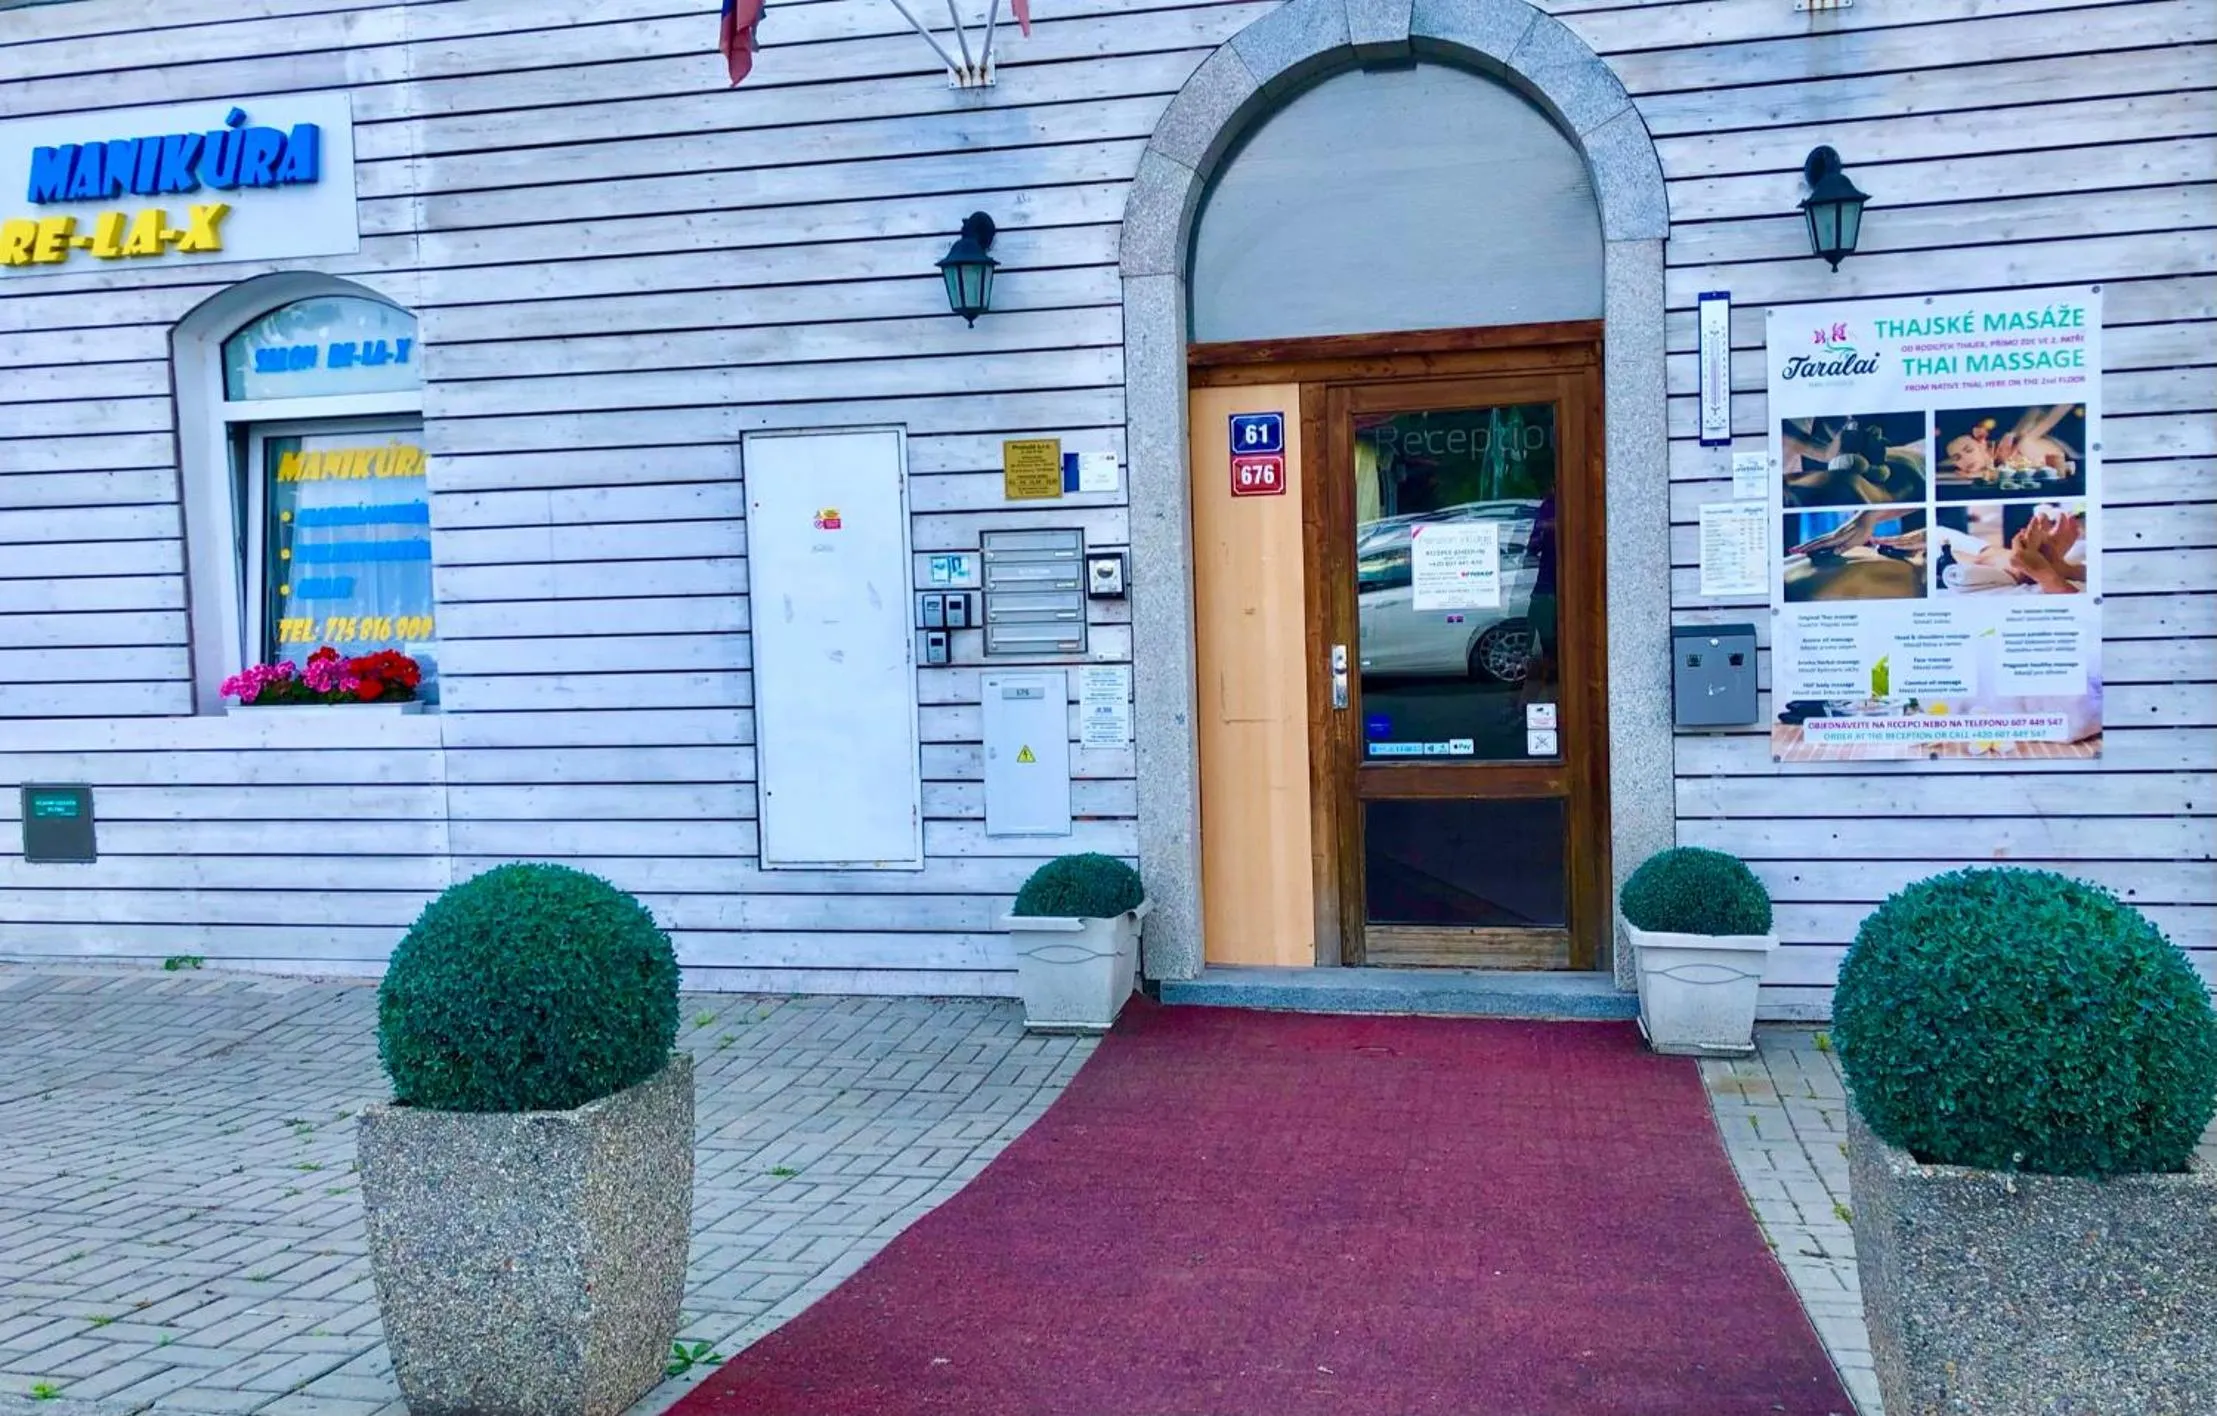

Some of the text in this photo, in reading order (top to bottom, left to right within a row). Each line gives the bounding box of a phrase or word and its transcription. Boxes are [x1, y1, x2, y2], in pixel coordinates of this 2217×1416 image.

[28, 106, 319, 204] MANIKÚRA
[0, 203, 228, 267] RE-LA-X
[1873, 304, 2085, 339] THAJSKÉ MASÁŽE
[1782, 351, 1880, 381] Taralai
[1902, 348, 2085, 377] THAI MASSAGE
[1244, 424, 1269, 445] 61
[1240, 464, 1275, 485] 676
[1923, 719, 1947, 728] NEBO
